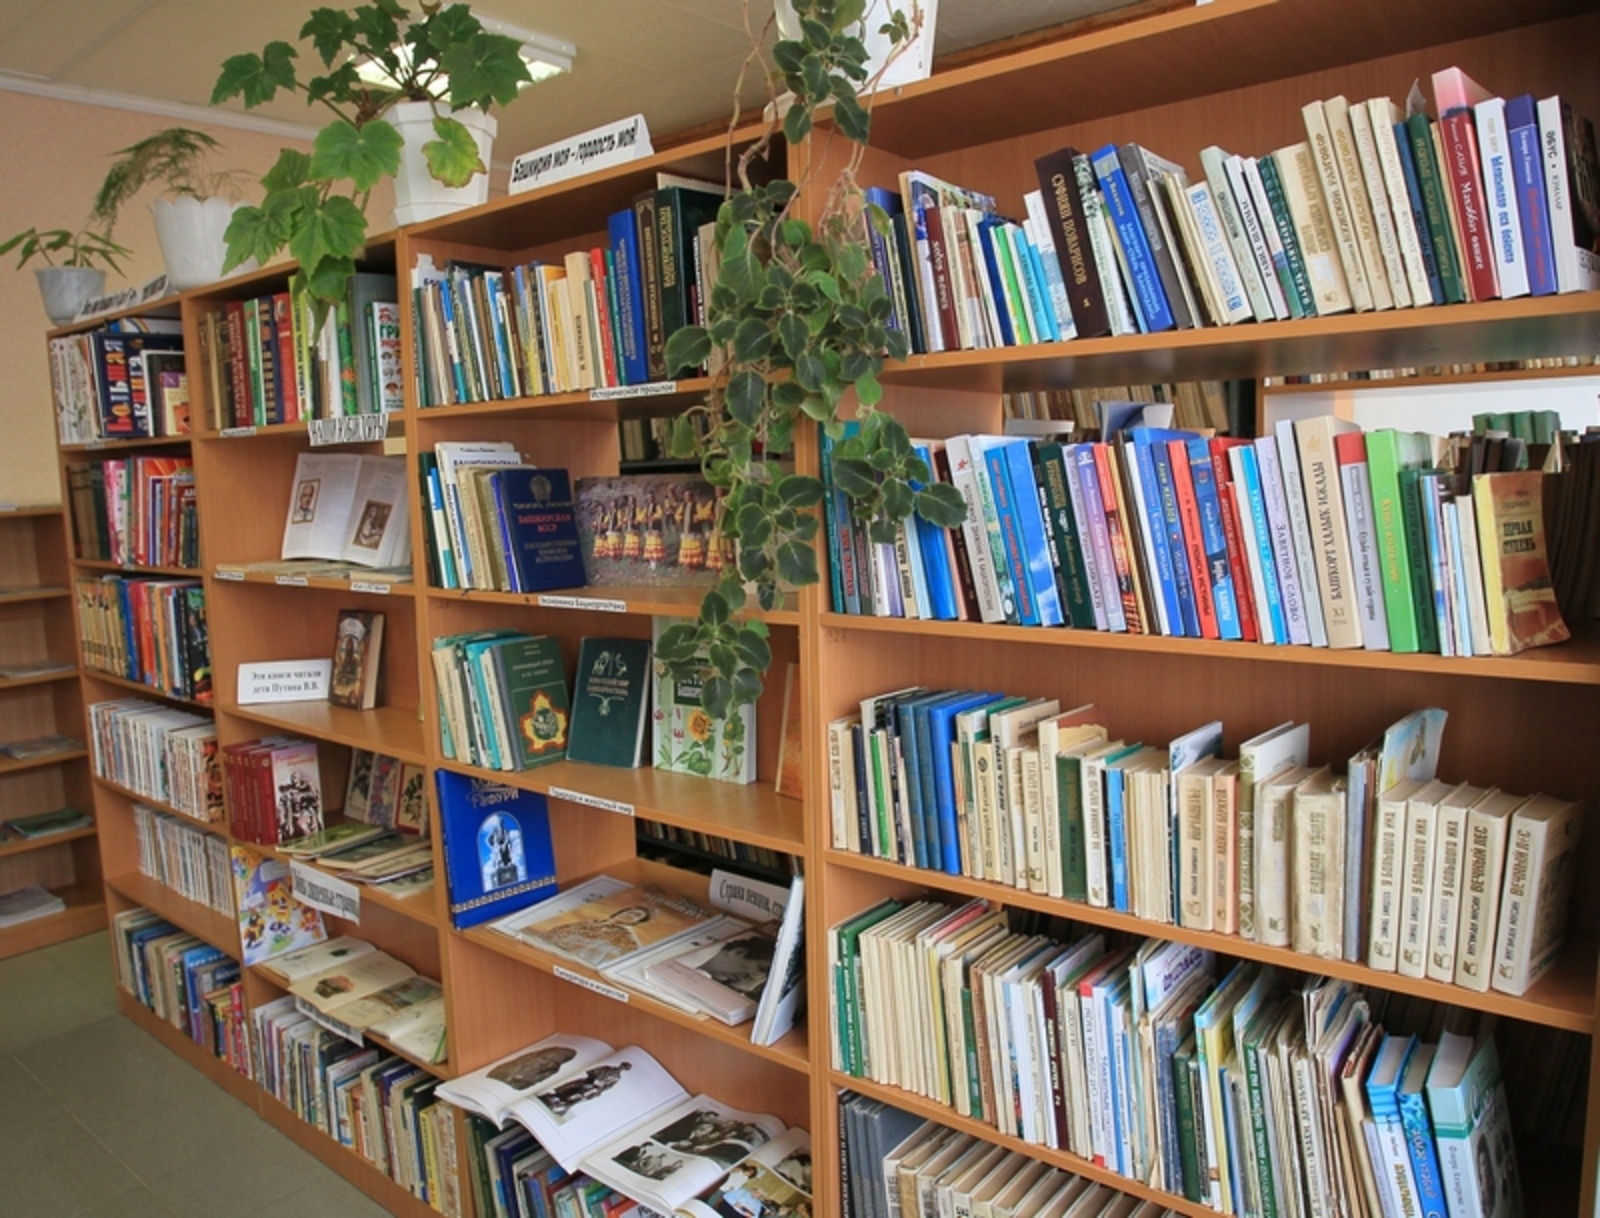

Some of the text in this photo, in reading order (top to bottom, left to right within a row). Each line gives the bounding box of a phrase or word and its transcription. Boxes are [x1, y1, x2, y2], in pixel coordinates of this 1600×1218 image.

[577, 133, 616, 165] гордость
[1051, 174, 1074, 225] СУФИЯН
[103, 338, 133, 432] Большая
[1503, 519, 1533, 537] ПЕРВАЯ
[1275, 524, 1299, 622] ЗАВЕТНОЕ СЛОВО
[251, 685, 270, 695] дети
[271, 682, 303, 695] Путина
[267, 671, 291, 681] книги
[293, 670, 322, 680] читали
[1473, 825, 1488, 848] ЛЕС
[1514, 828, 1531, 850] ЛЕС
[1469, 847, 1486, 894] ВЕЧНЫЙ
[1509, 849, 1528, 897] ВЕЧНЫЙ
